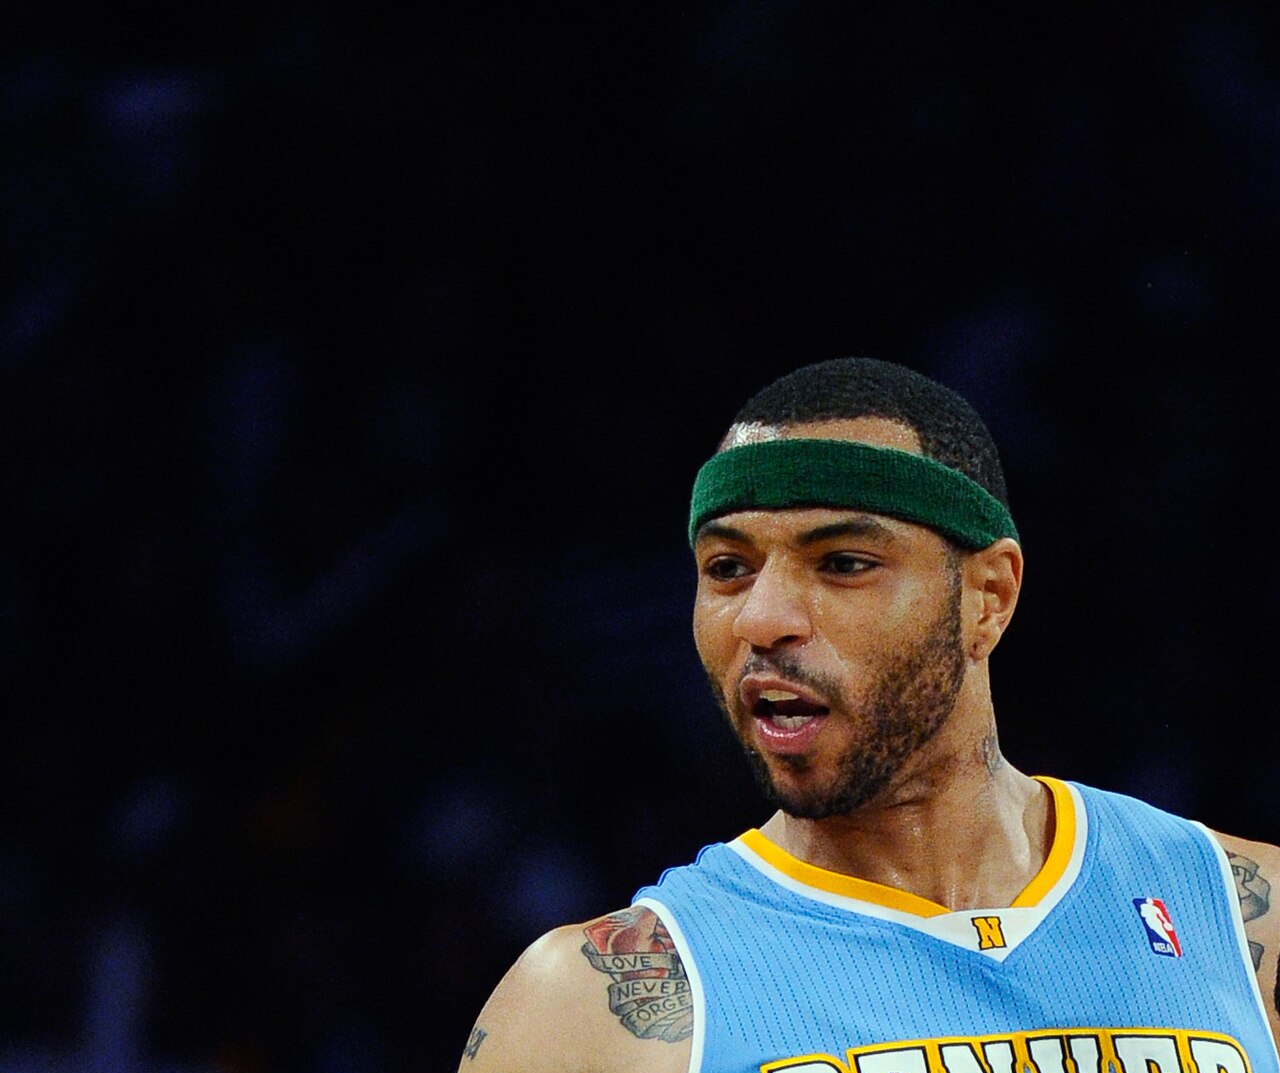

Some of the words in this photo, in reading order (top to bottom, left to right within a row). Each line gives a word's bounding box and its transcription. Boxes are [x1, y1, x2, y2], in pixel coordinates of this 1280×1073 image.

[971, 916, 1007, 950] N
[1153, 942, 1174, 955] NBA
[601, 955, 653, 971] LOVE
[616, 981, 690, 1001] NEVER
